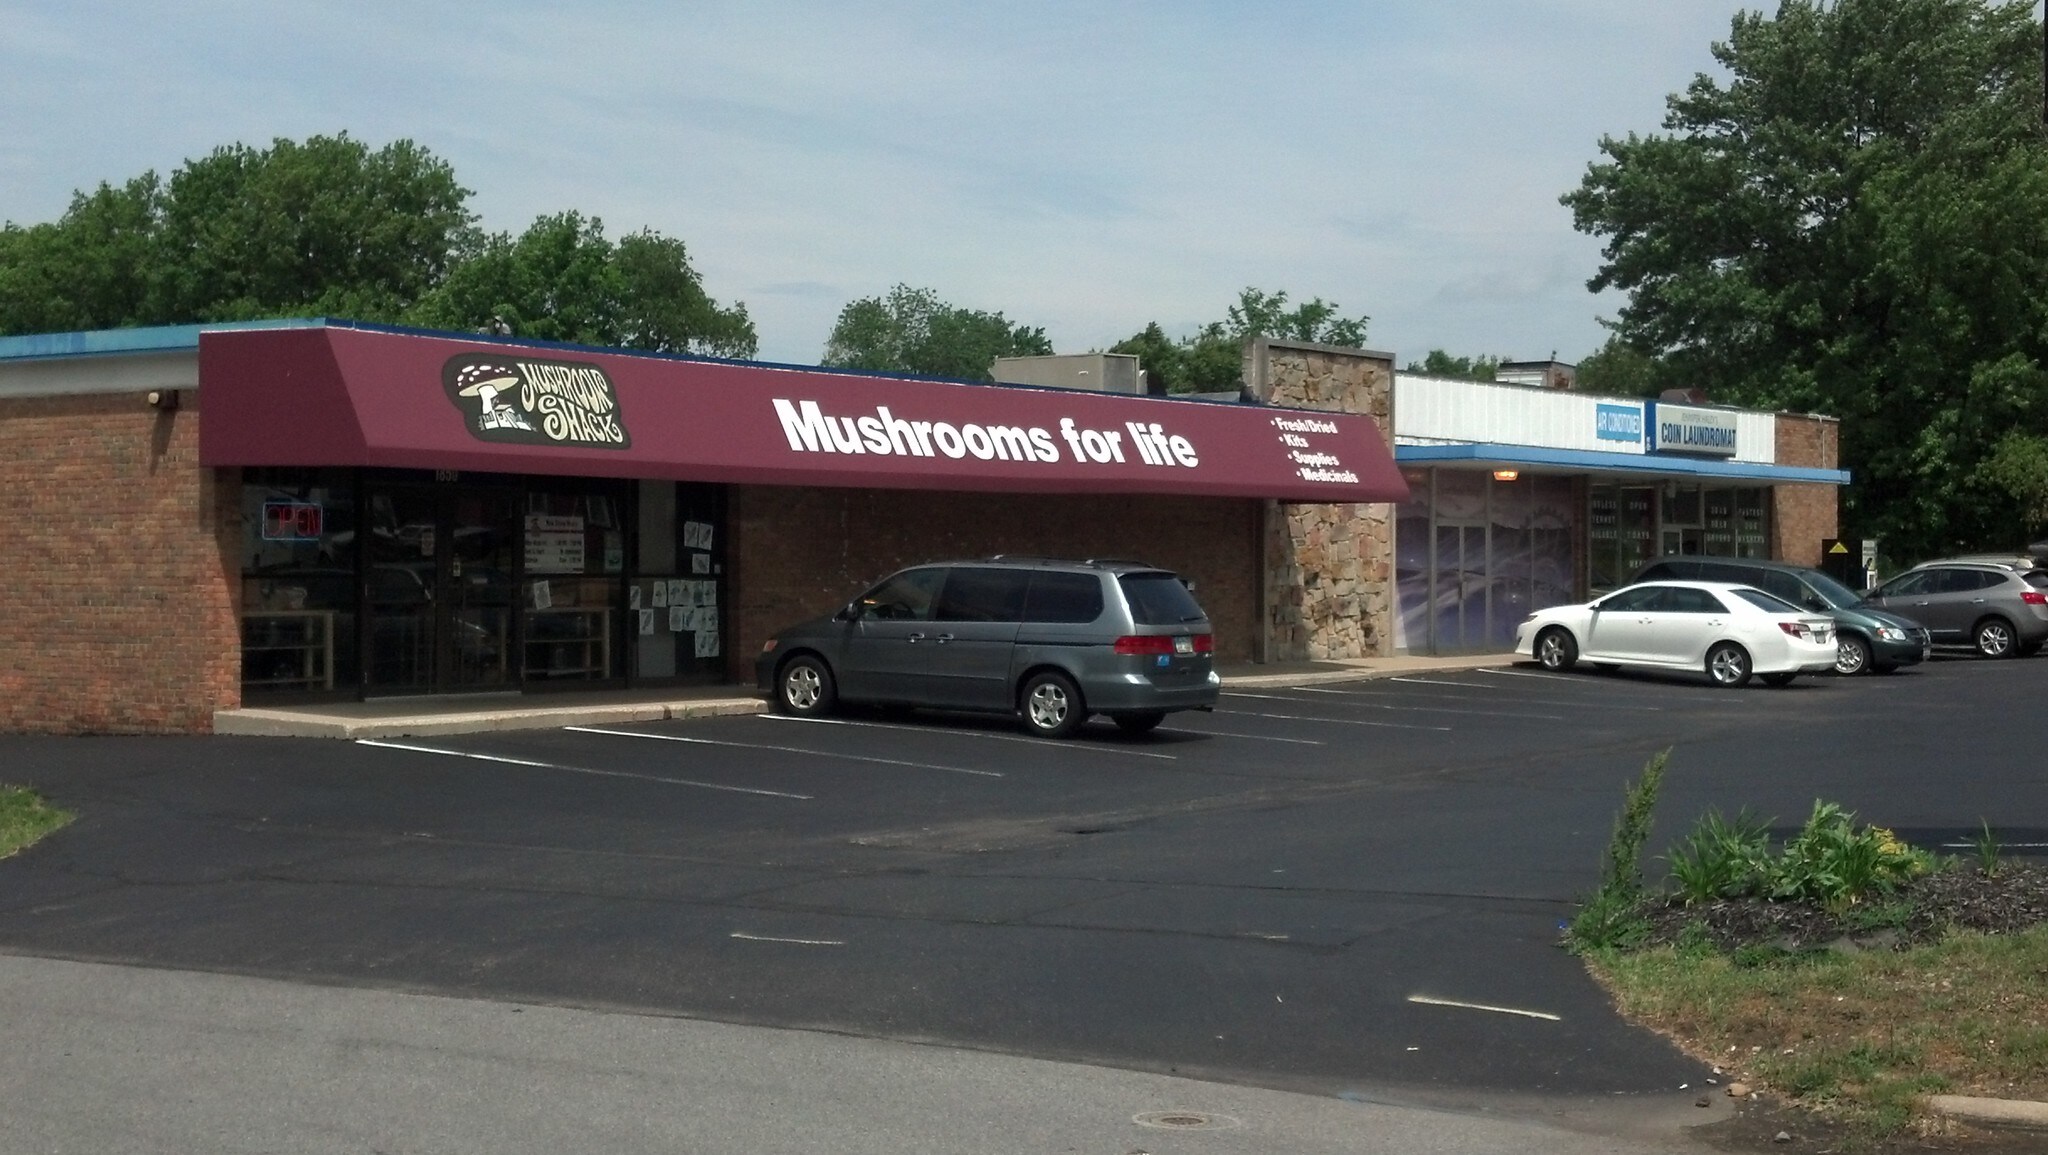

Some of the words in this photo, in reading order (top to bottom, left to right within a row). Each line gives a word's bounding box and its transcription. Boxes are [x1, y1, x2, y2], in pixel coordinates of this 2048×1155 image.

[516, 363, 613, 413] MUSHROOM
[538, 395, 623, 443] SHACK
[1274, 417, 1338, 433] Fresh/Dried
[772, 398, 1060, 463] Mushrooms
[1060, 417, 1126, 464] for
[1126, 421, 1199, 468] life
[1283, 433, 1309, 447] Kits
[1661, 422, 1682, 443] COIN
[1683, 424, 1737, 448] LAUNDROMAT
[1292, 450, 1340, 467] Supplies
[1300, 467, 1359, 483] Medicinals
[265, 505, 320, 537] OPEN
